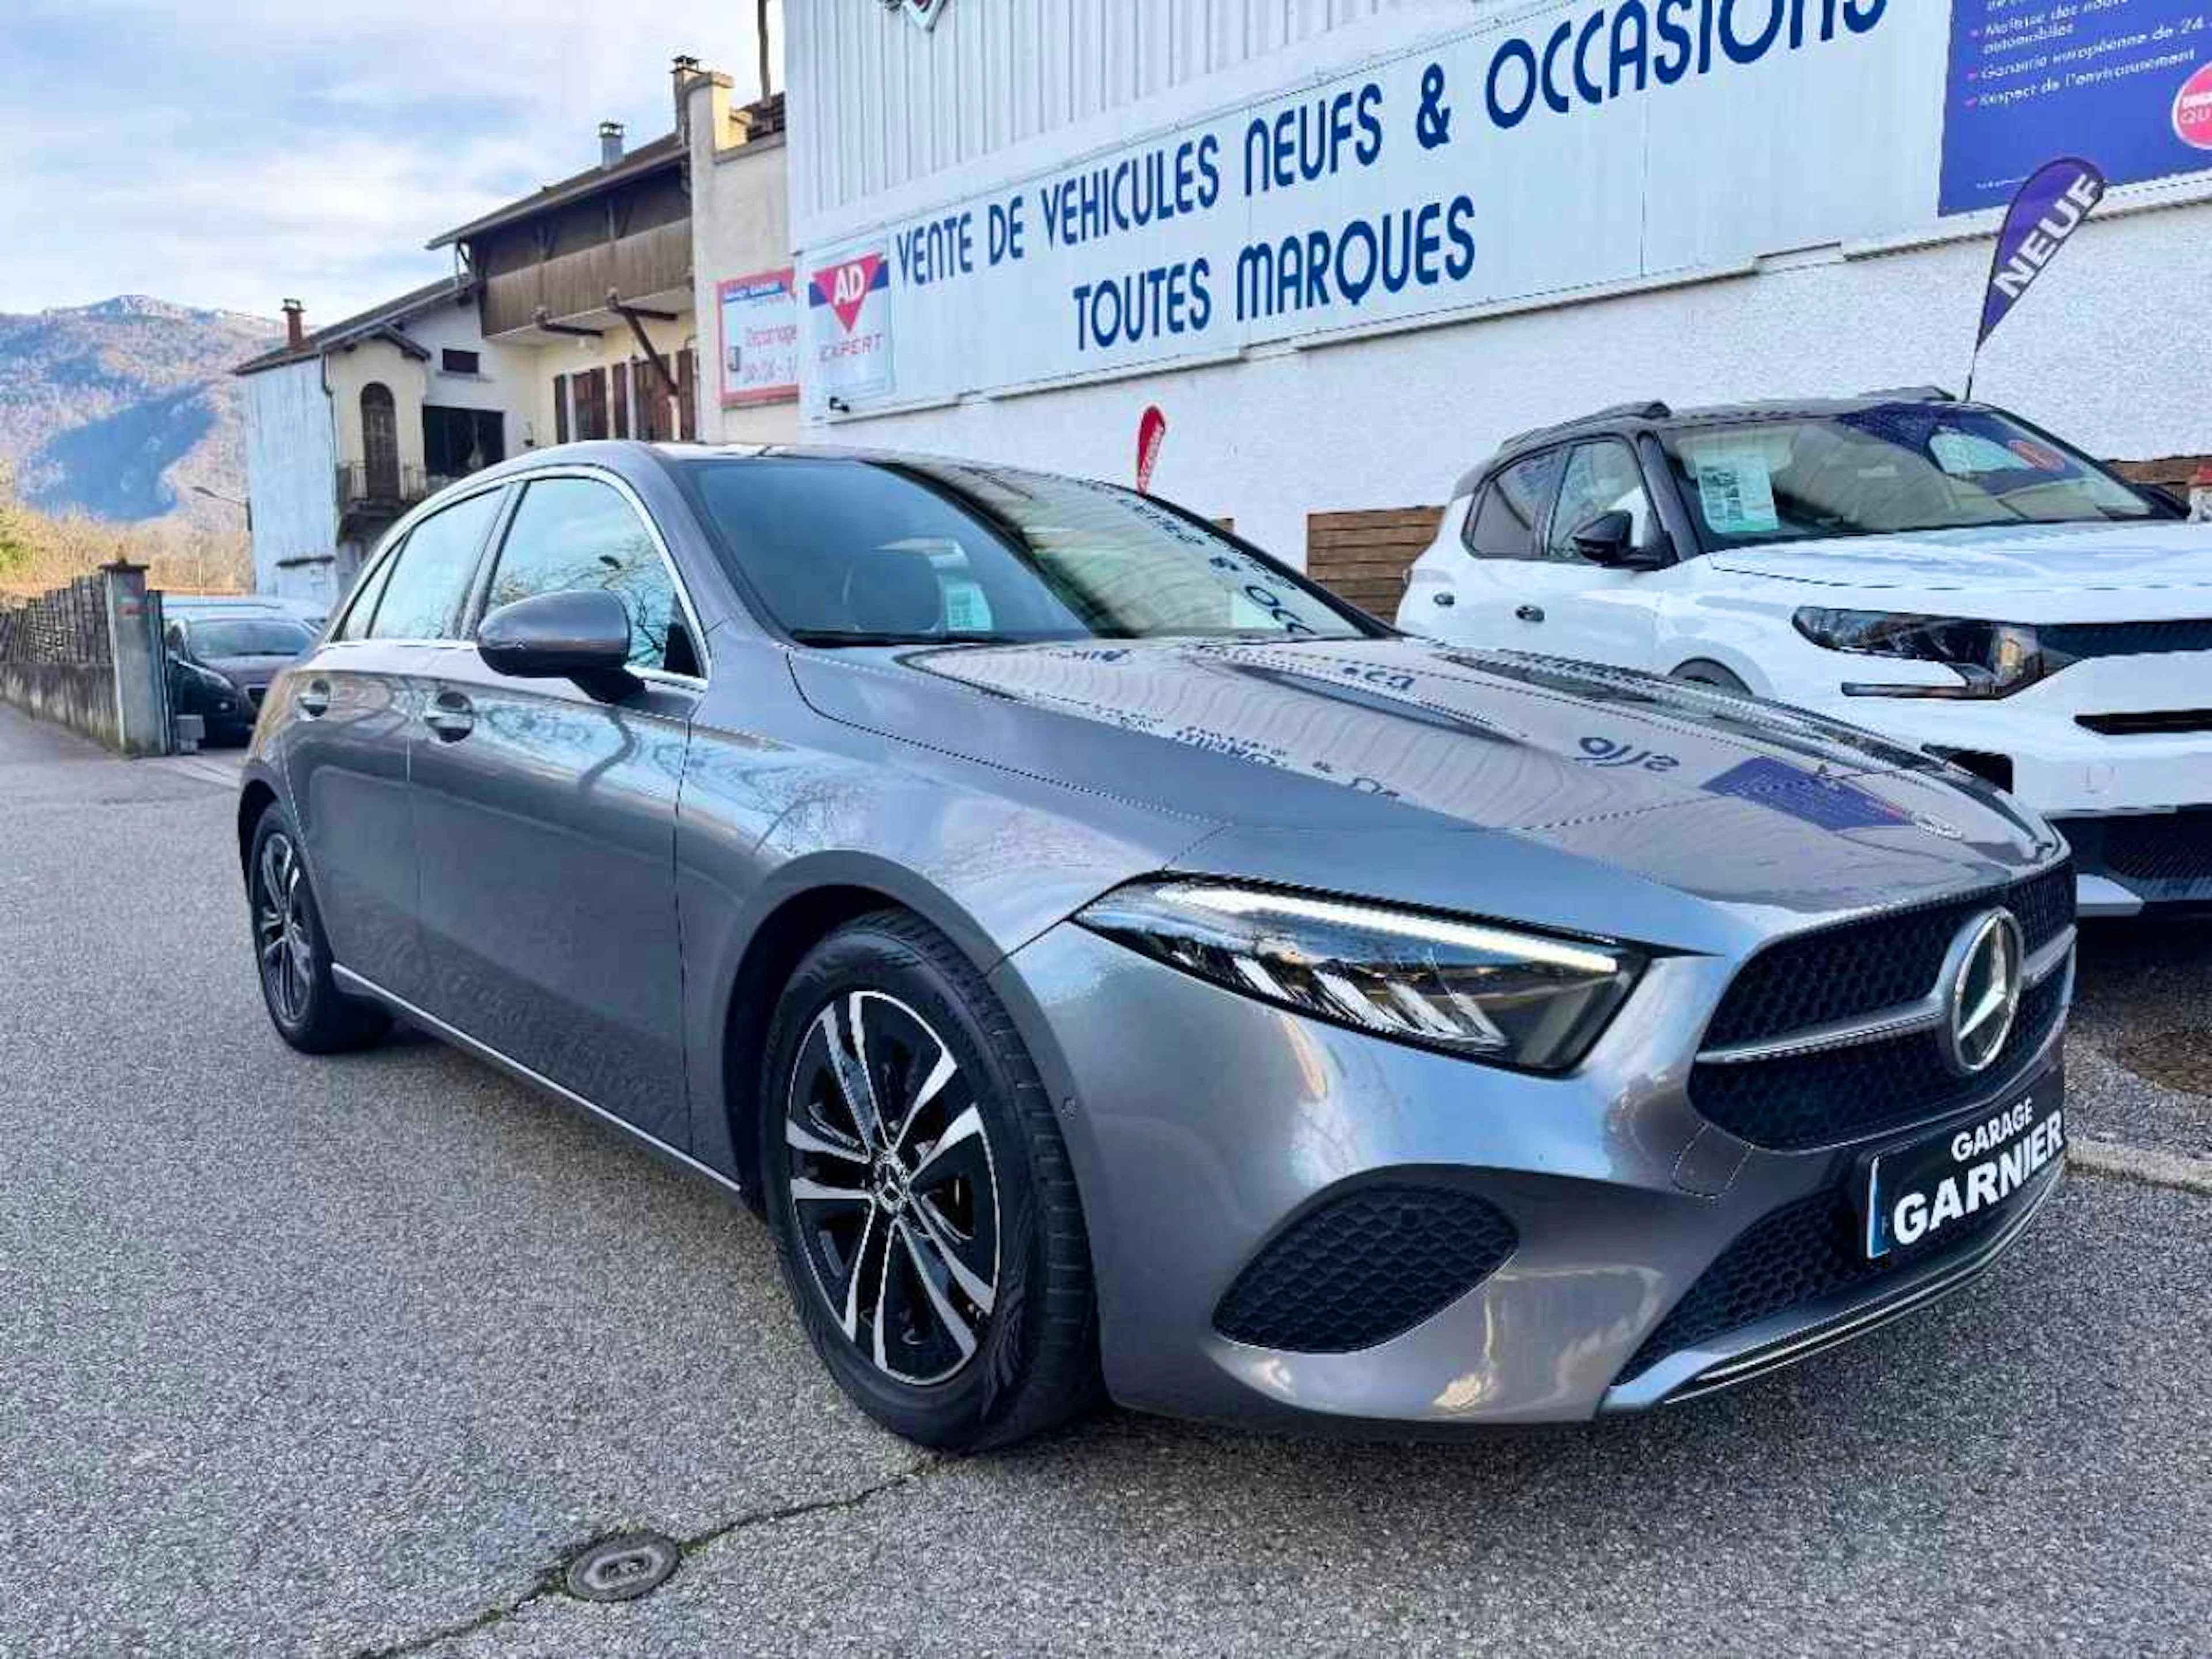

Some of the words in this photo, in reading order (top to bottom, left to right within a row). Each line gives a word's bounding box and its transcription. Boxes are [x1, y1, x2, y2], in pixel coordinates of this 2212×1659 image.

[896, 212, 973, 286] VENTE
[988, 195, 1024, 266] DE
[1040, 134, 1219, 250] VEHICULES
[1244, 82, 1383, 197] NEUFS
[1415, 62, 1452, 150] &
[1992, 173, 2097, 298] NEUF
[833, 263, 865, 308] AD
[1073, 257, 1211, 351] TOUTES
[1236, 195, 1476, 322] MARQUES
[819, 331, 884, 362] EXPERT
[1893, 1109, 2065, 1245] GARNIER
[1950, 1096, 2033, 1162] GARAGE
